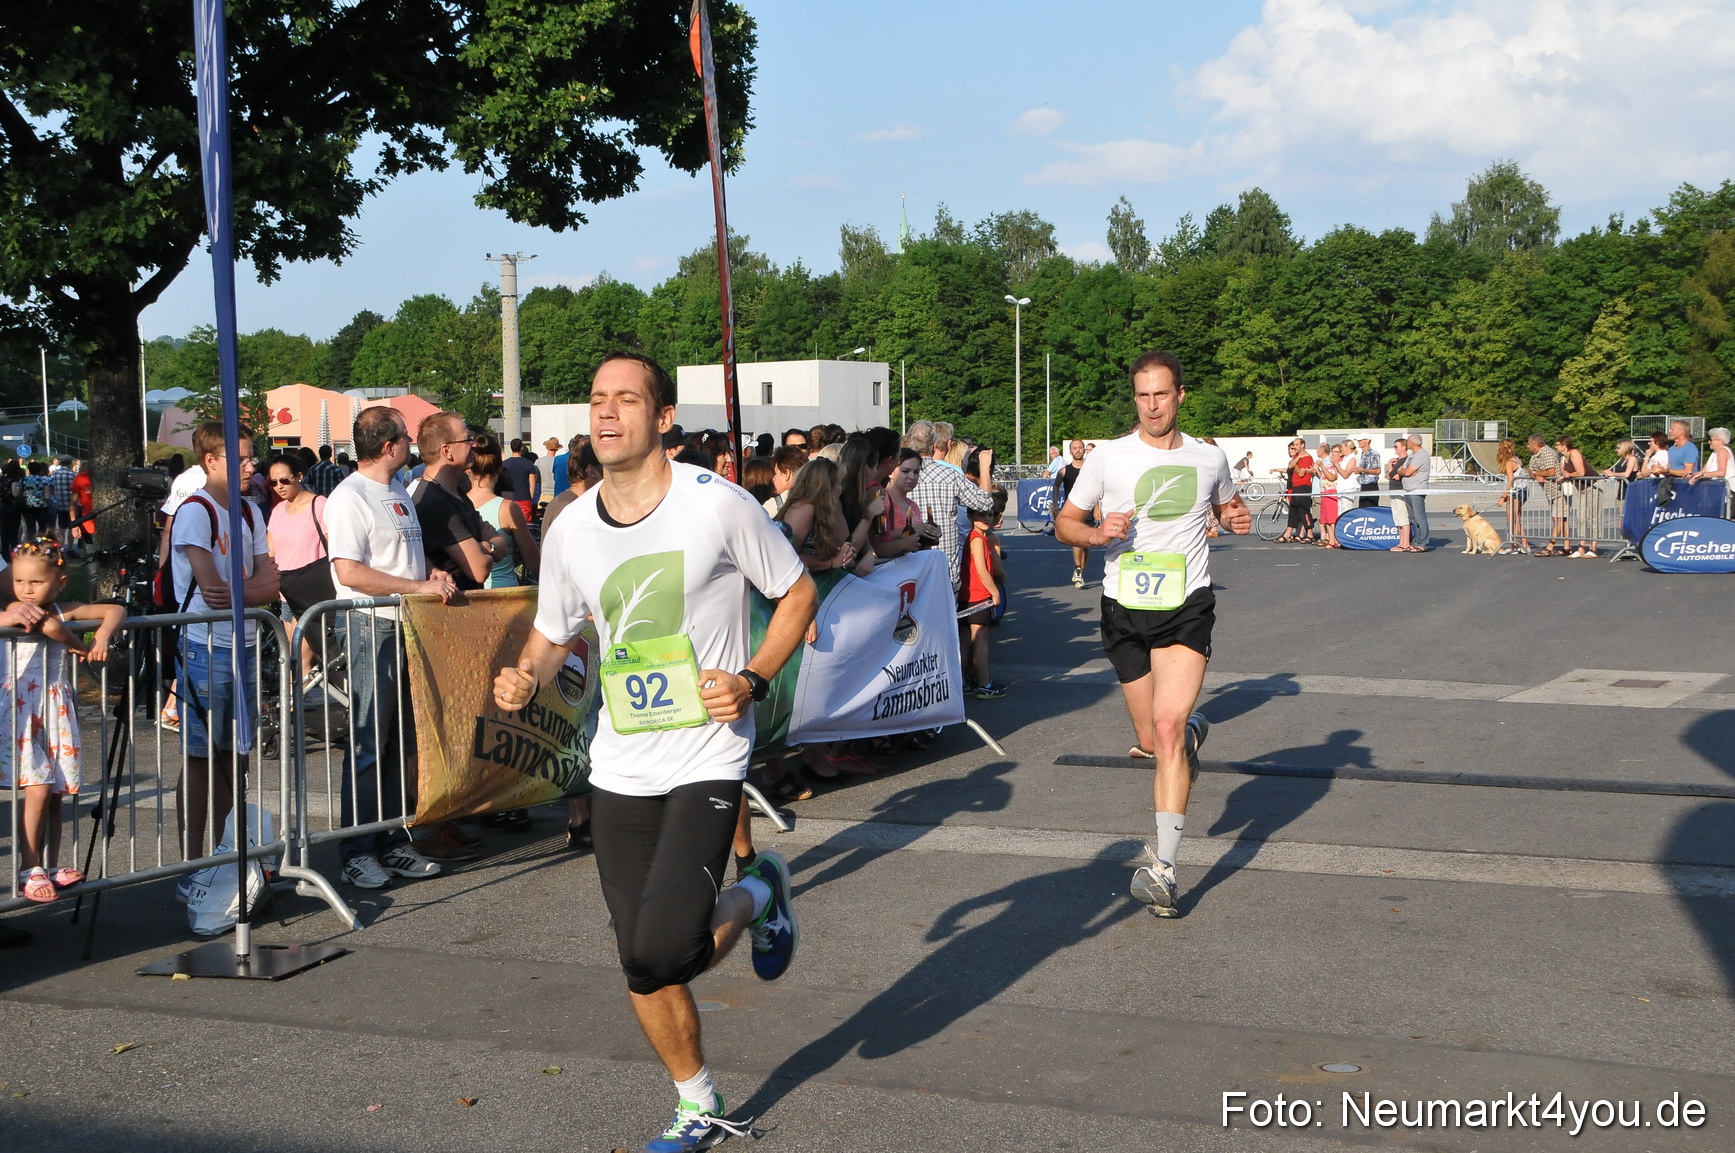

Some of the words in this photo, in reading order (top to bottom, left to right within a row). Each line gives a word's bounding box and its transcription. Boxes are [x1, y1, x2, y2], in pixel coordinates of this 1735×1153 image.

[713, 477, 748, 502] Bionorica
[1650, 506, 1701, 525] Fisch
[1135, 572, 1166, 595] 97
[897, 629, 915, 642] 1628
[882, 652, 938, 685] Neumarkter
[625, 672, 674, 711] 92
[872, 673, 950, 720] Lammsbräu
[629, 711, 649, 719] Thomas
[639, 717, 666, 726] BIONORICA
[474, 716, 585, 793] Lammsb
